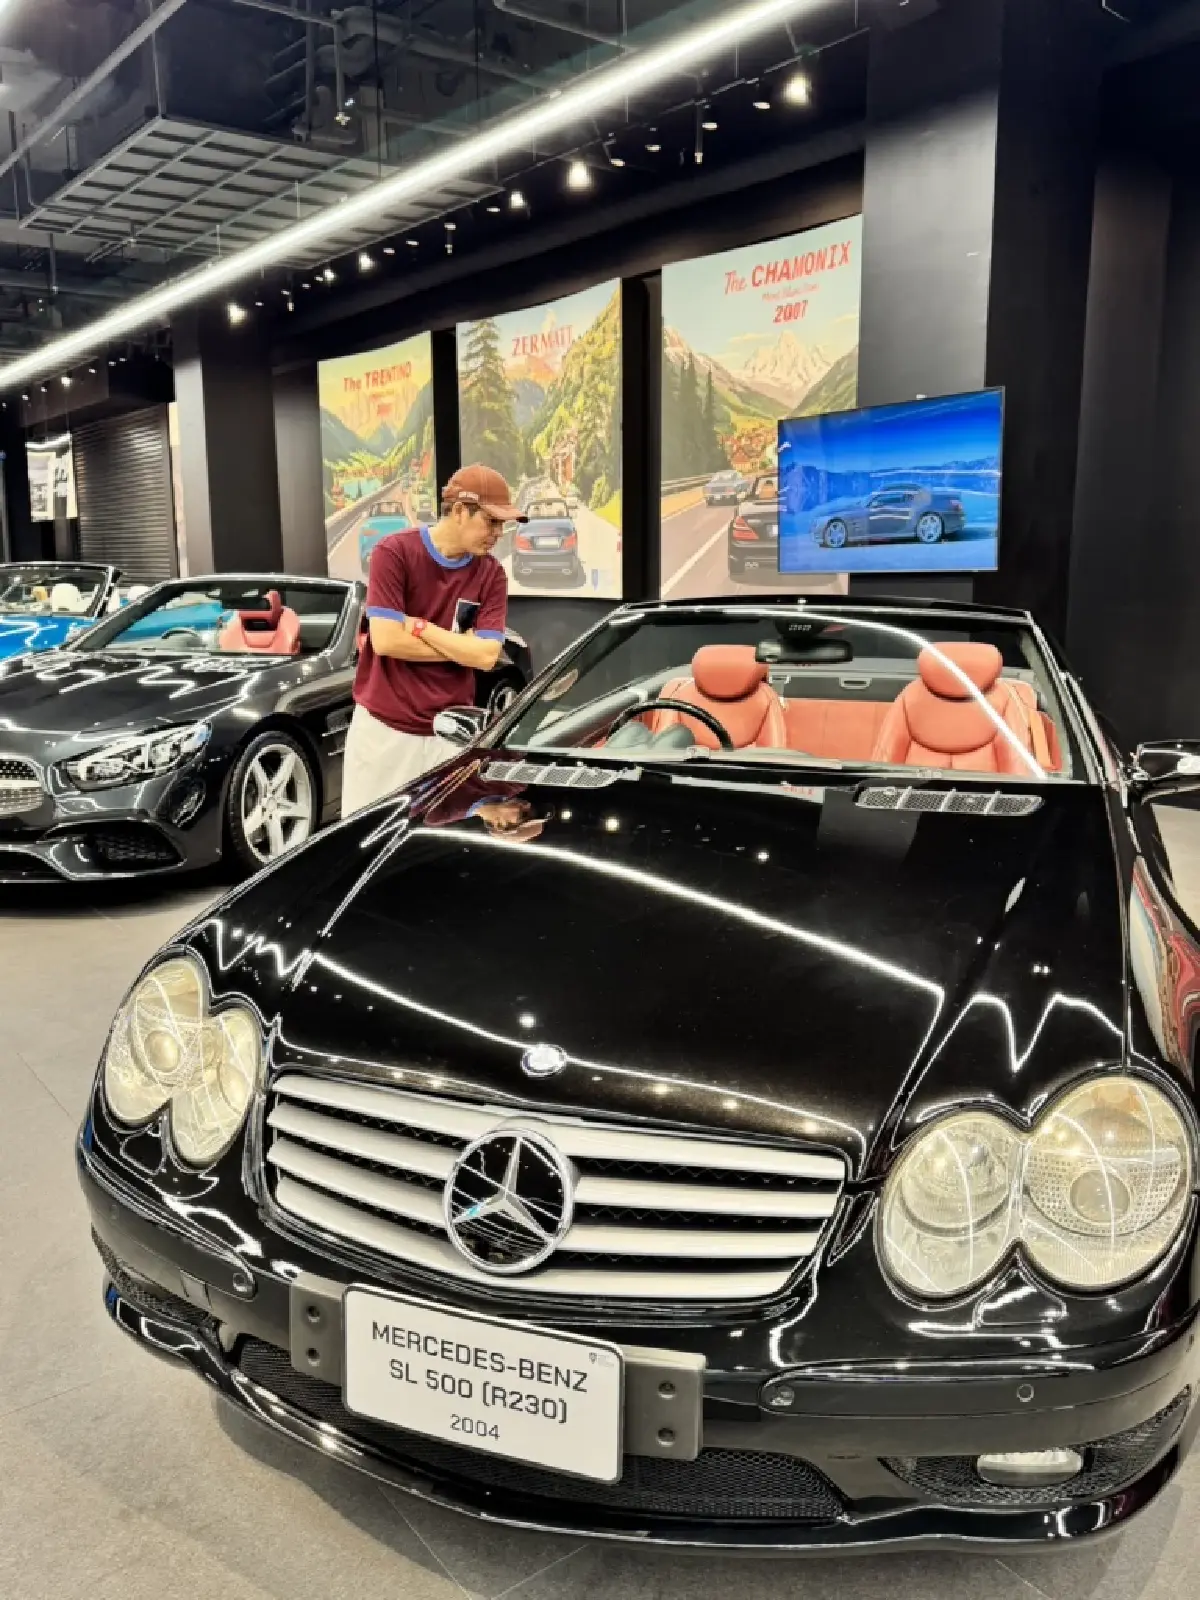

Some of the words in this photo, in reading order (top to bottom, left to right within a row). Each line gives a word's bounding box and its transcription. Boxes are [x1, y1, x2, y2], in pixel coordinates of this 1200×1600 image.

[724, 270, 747, 295] The
[751, 240, 852, 288] CHAMONIX
[773, 300, 809, 323] 2007
[511, 325, 573, 357] ZERMATT
[343, 377, 362, 392] The
[364, 361, 412, 390] TRENTINO
[372, 1320, 588, 1393] MERCEDES-BENZ
[389, 1358, 418, 1384] SL
[425, 1369, 473, 1399] 500
[482, 1380, 568, 1424] (R230)
[450, 1413, 501, 1440] 2004
